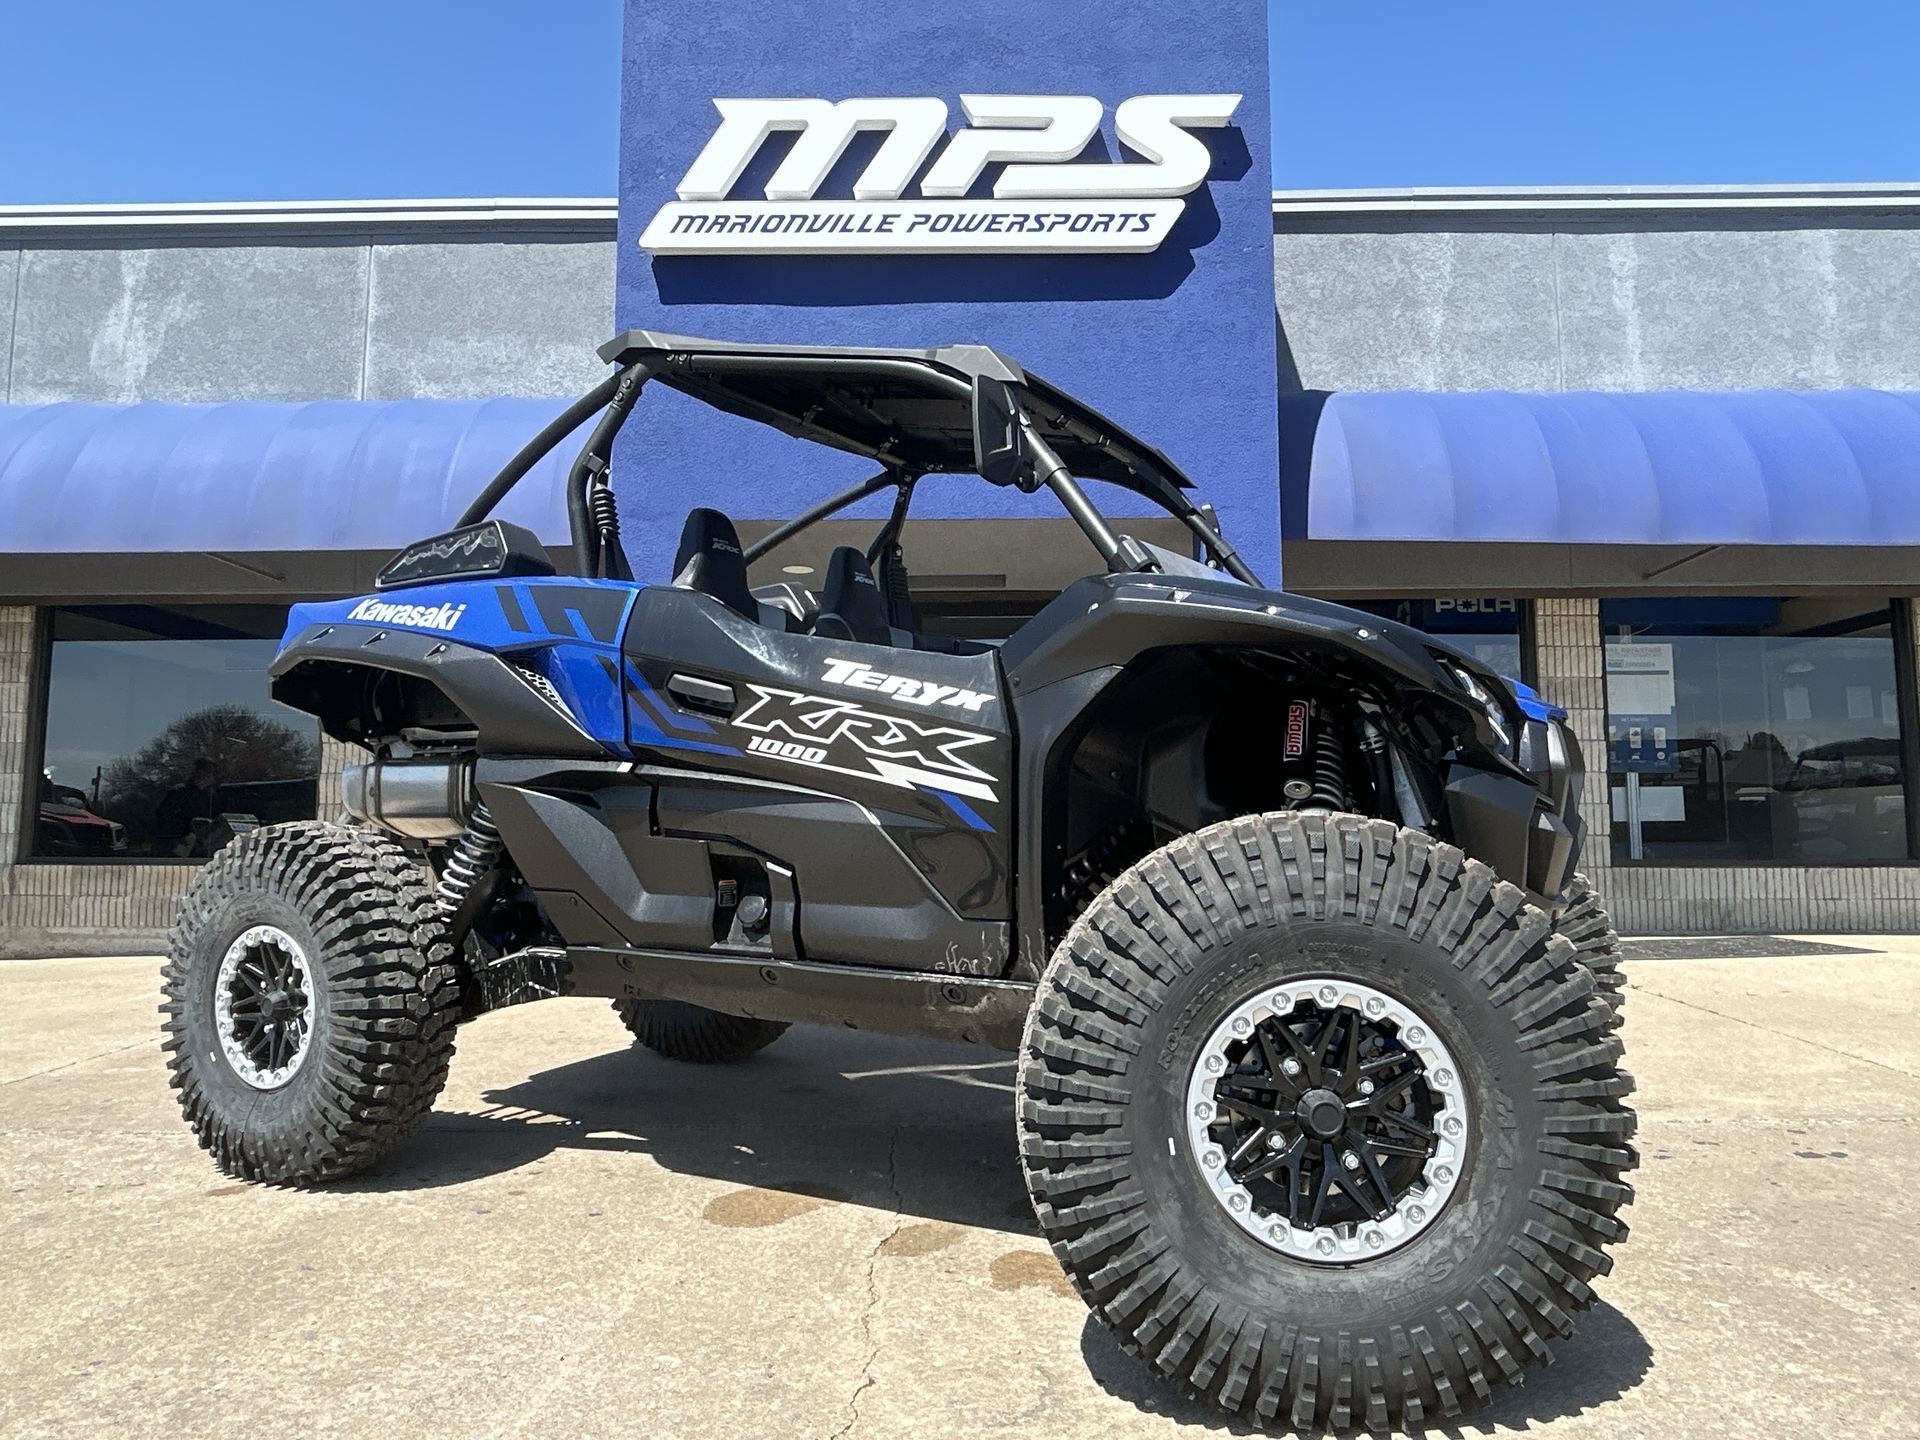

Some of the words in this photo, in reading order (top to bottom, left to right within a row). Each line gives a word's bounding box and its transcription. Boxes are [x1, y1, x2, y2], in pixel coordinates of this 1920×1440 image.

[676, 94, 1243, 199] MPS
[670, 214, 902, 233] MARIONVILLE
[906, 213, 1157, 233] POWERSPORTS
[347, 599, 467, 631] Kawasaki
[731, 683, 999, 782] KRX
[747, 736, 828, 763] 1000
[1286, 705, 1304, 755] SHOWA
